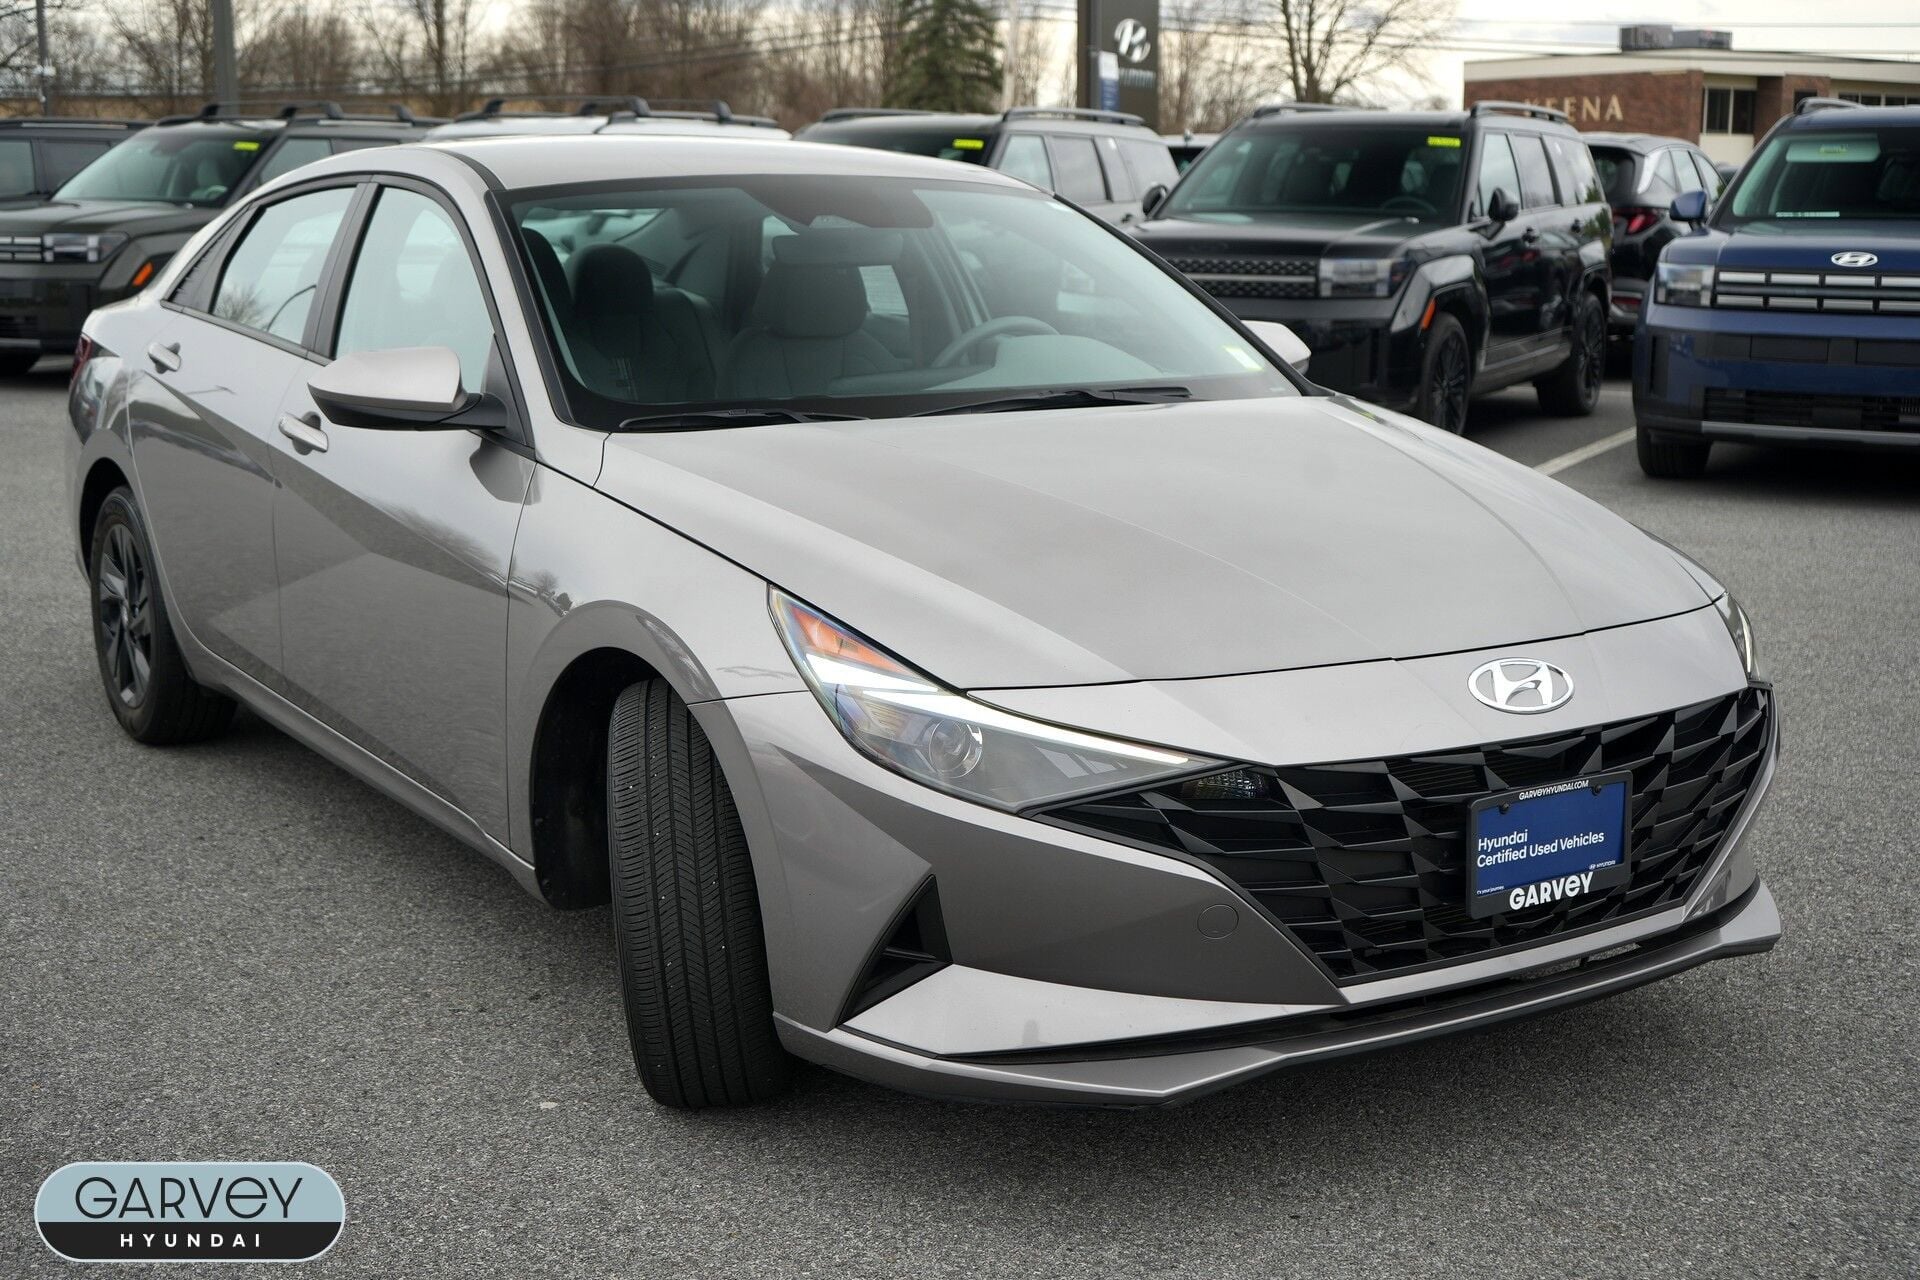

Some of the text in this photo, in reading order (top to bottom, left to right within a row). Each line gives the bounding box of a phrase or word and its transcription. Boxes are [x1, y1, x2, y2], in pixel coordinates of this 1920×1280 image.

[1477, 832, 1605, 868] Certified Used Vehicles
[1478, 829, 1528, 852] Hyundai
